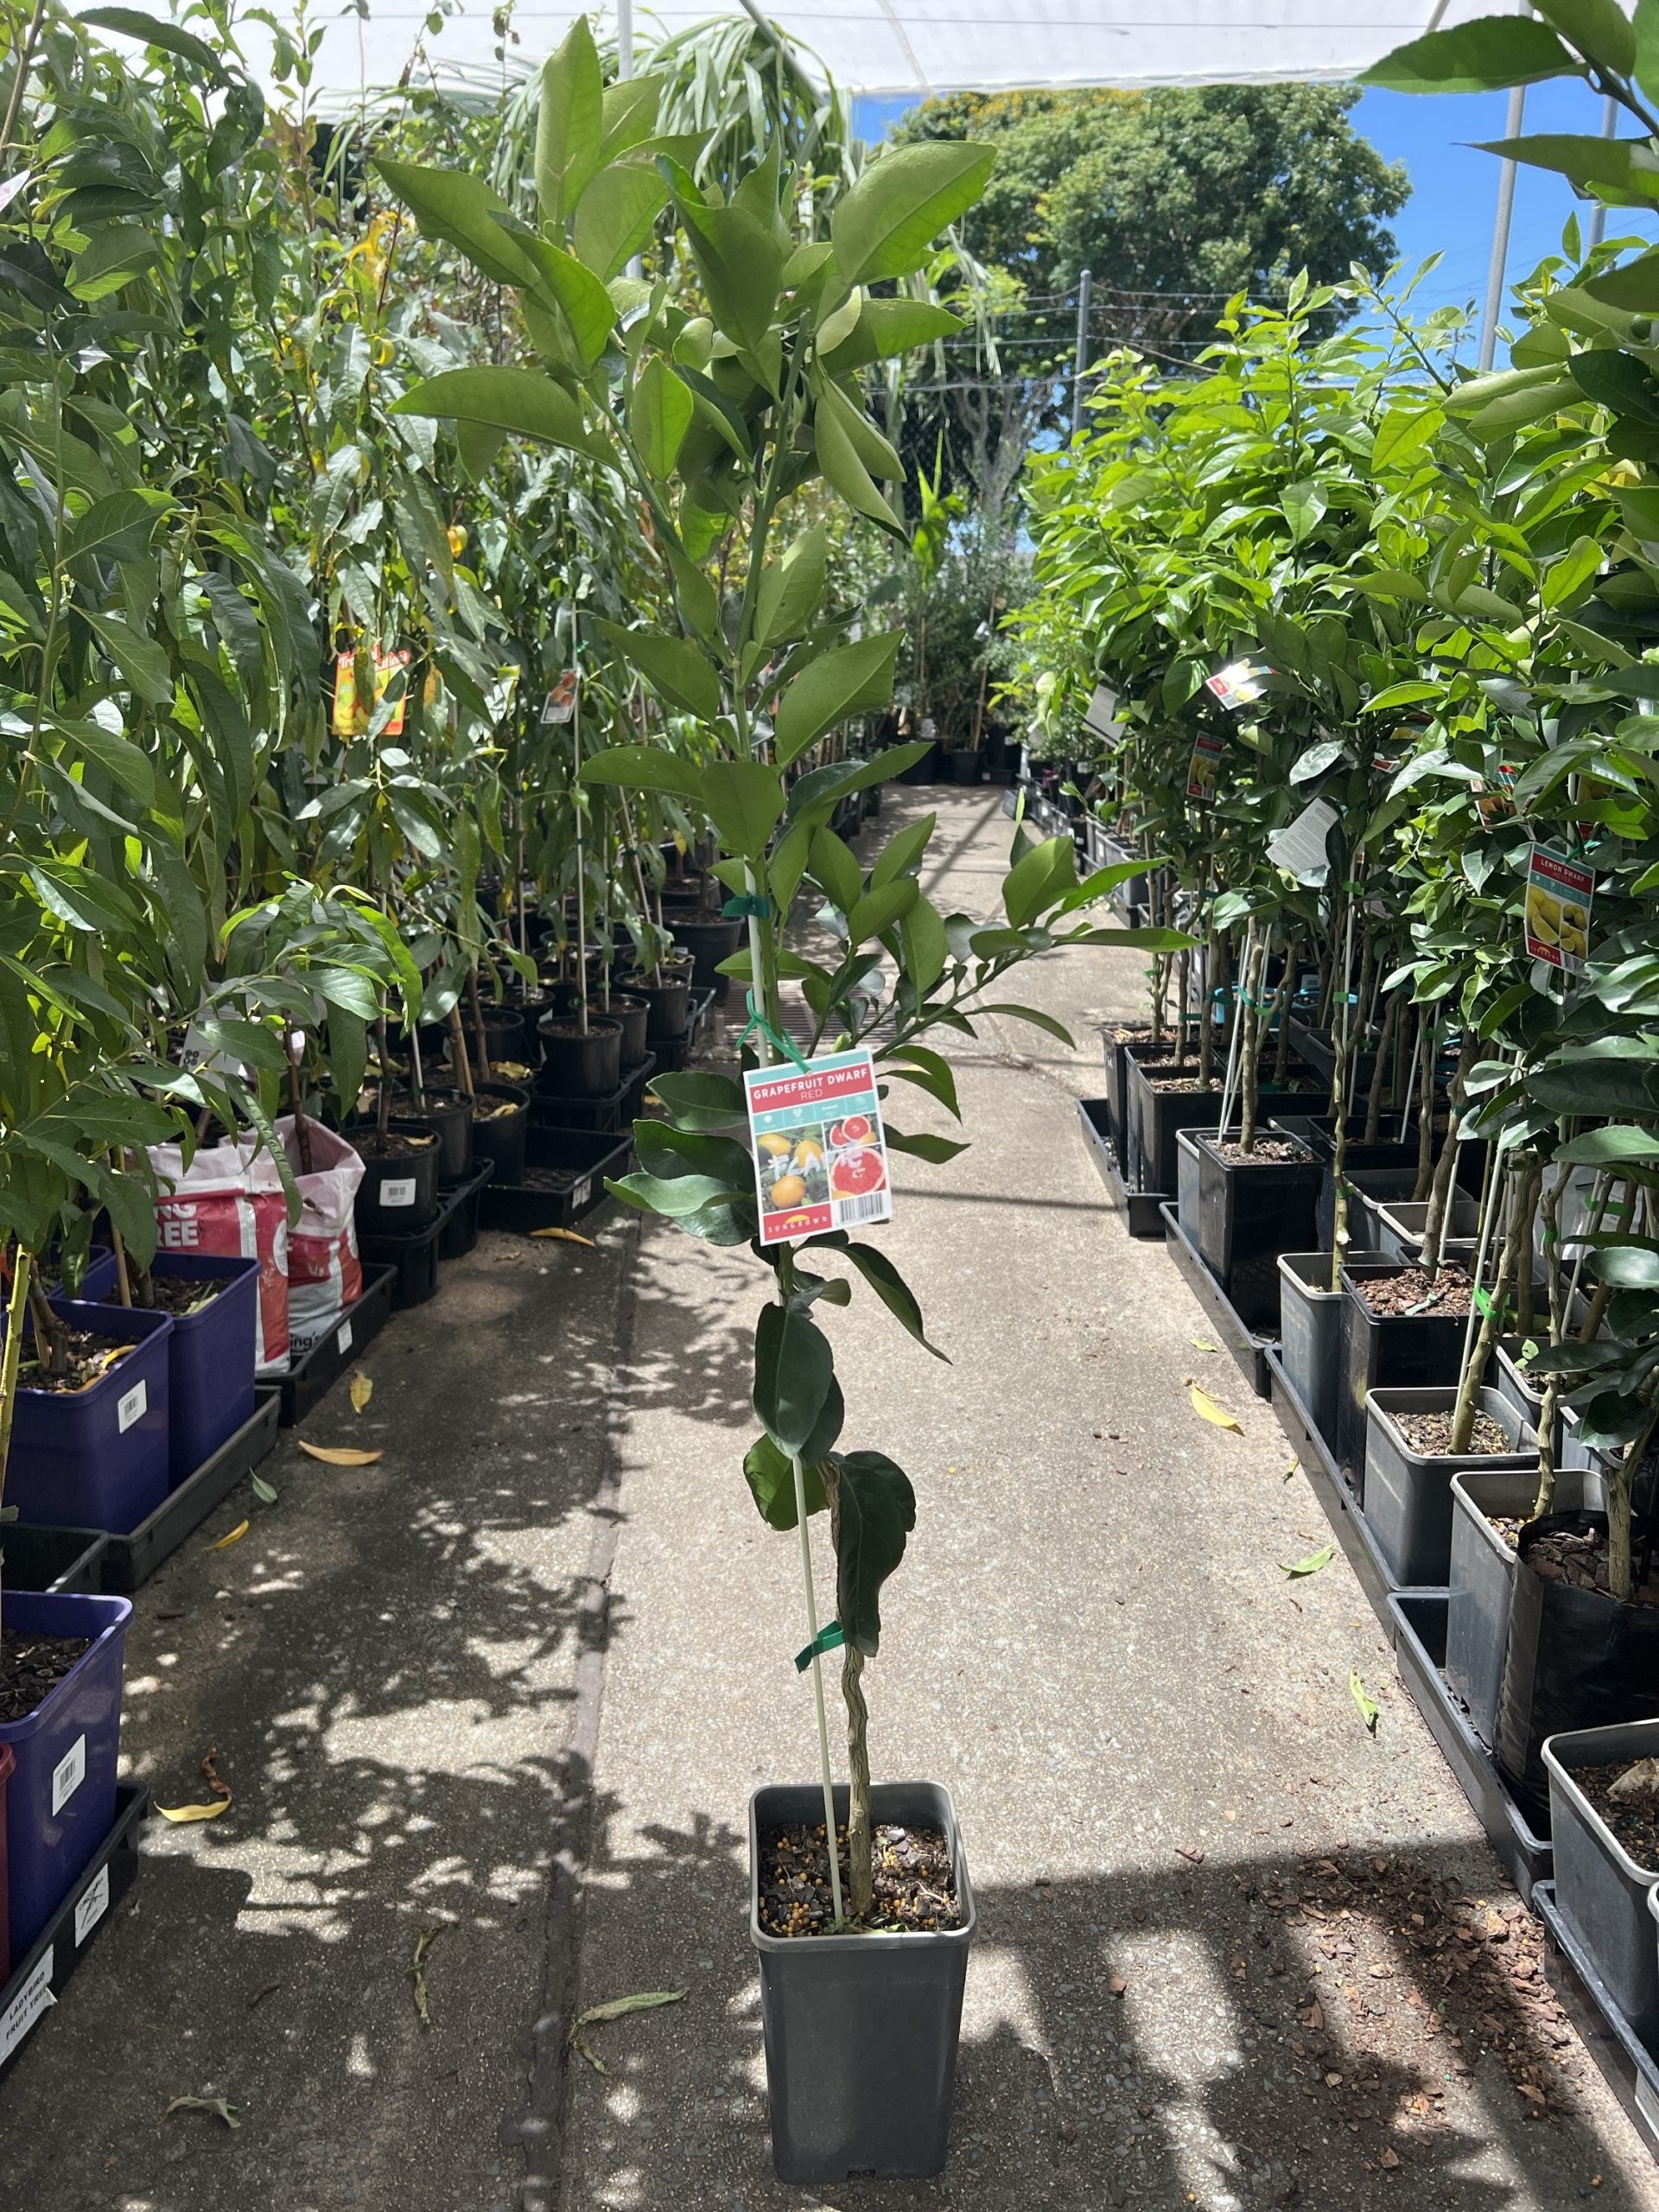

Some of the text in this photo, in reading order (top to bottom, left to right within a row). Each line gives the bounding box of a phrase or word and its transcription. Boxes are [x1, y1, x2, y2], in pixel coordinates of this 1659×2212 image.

[1541, 858, 1585, 882] LEMON DWARF
[753, 1068, 868, 1100] GRAPEFRUIT DWARF
[800, 1089, 823, 1100] RED
[768, 1216, 828, 1233] SUNGROWN
[10, 1971, 45, 2021] LADYBIRD
[6, 2006, 28, 2040] FRUIT
